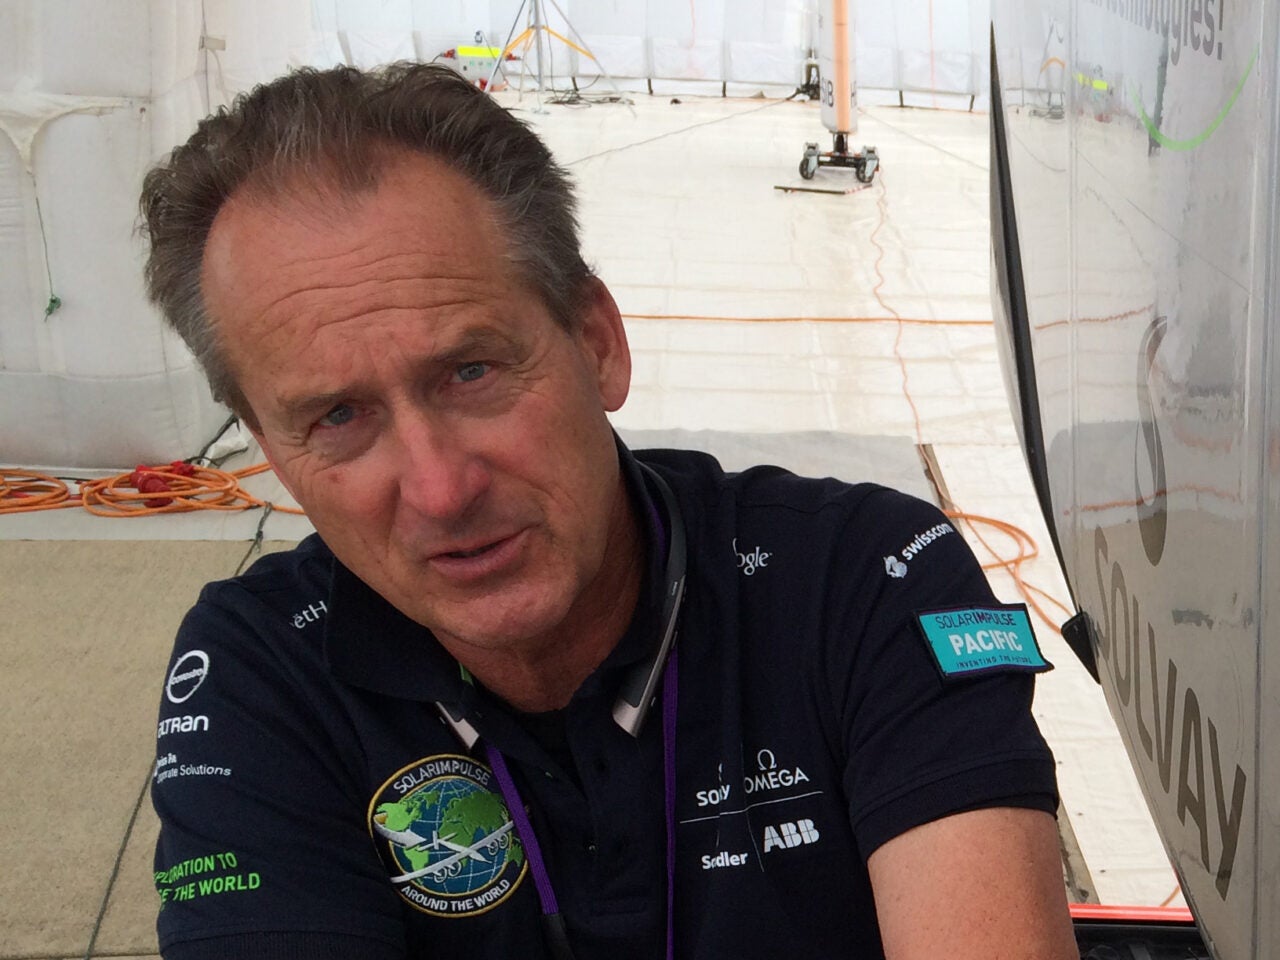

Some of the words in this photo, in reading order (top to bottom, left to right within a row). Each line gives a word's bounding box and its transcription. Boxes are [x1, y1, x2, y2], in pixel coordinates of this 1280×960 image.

[902, 522, 954, 562] swisscom
[935, 613, 1016, 630] SOLARIMPULSE
[949, 630, 1023, 656] PACIFIC
[1095, 525, 1247, 902] SOLVAY
[180, 764, 232, 777] Solutions
[393, 760, 492, 794] SOLARIMPULSE
[744, 766, 810, 794] OMEGA
[764, 818, 820, 853] ABB
[217, 852, 238, 870] TO
[173, 882, 196, 901] THE
[199, 873, 261, 897] WORLD
[402, 885, 448, 911] AROUND
[451, 898, 474, 911] THE
[474, 879, 511, 907] WORLD
